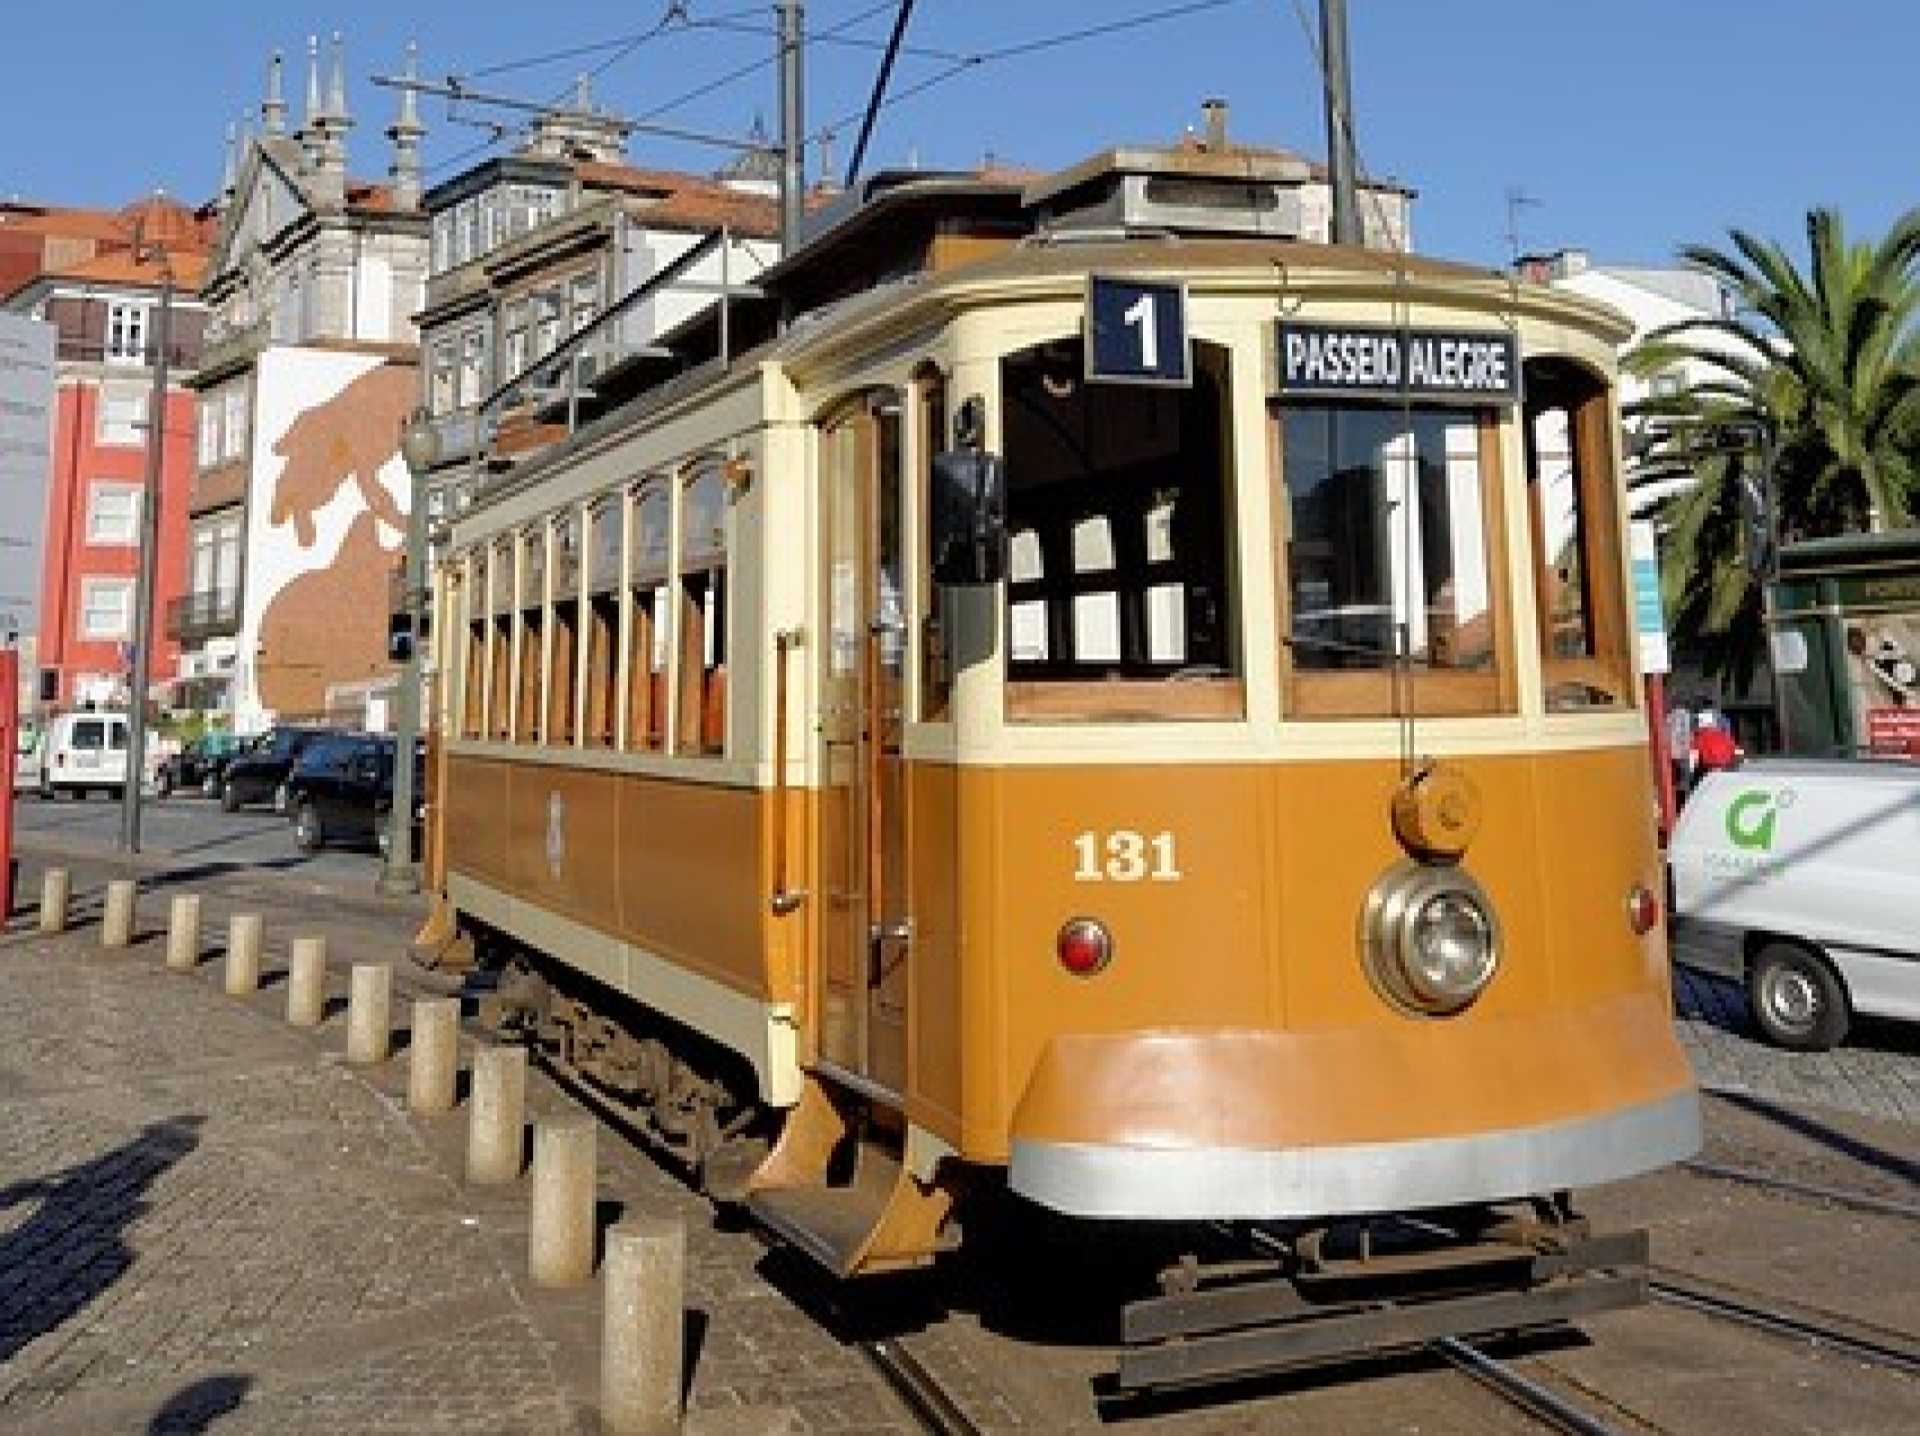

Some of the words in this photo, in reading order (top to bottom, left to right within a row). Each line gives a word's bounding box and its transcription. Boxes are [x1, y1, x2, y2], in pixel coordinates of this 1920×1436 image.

[1124, 293, 1157, 368] 1
[1286, 333, 1398, 385] PASSEIO
[1408, 339, 1506, 390] ALEGRE
[1074, 830, 1183, 882] 131
